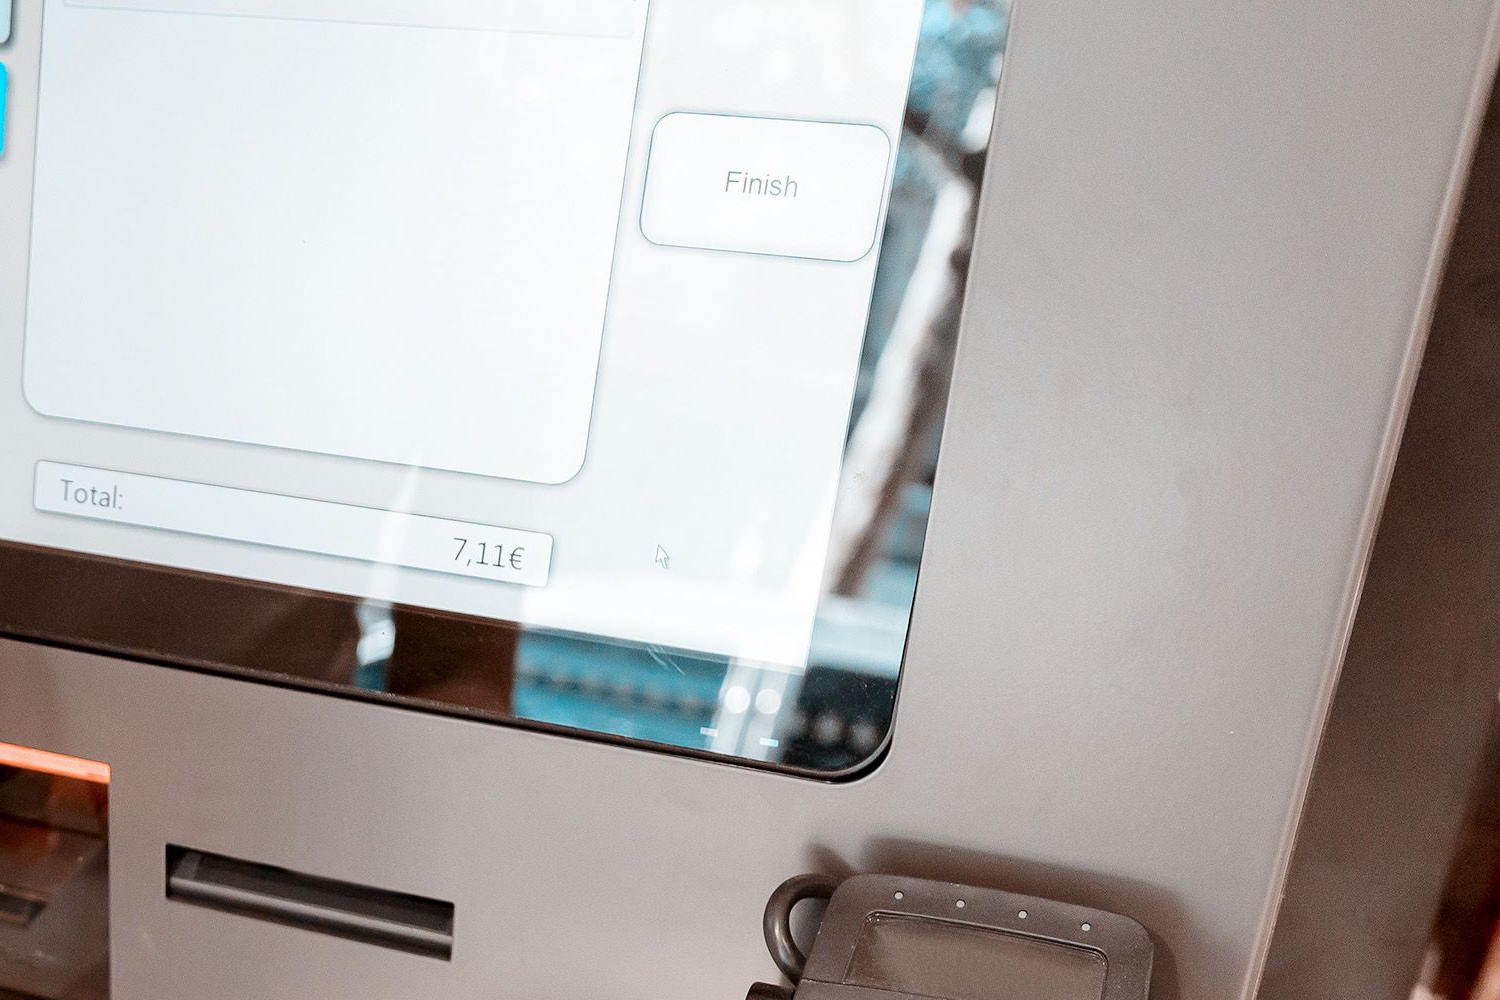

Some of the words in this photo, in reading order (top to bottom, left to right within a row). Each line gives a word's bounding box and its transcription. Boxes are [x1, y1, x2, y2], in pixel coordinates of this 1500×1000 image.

[724, 170, 798, 198] Finish
[60, 477, 125, 511] Total:
[453, 537, 525, 571] 7,11€
